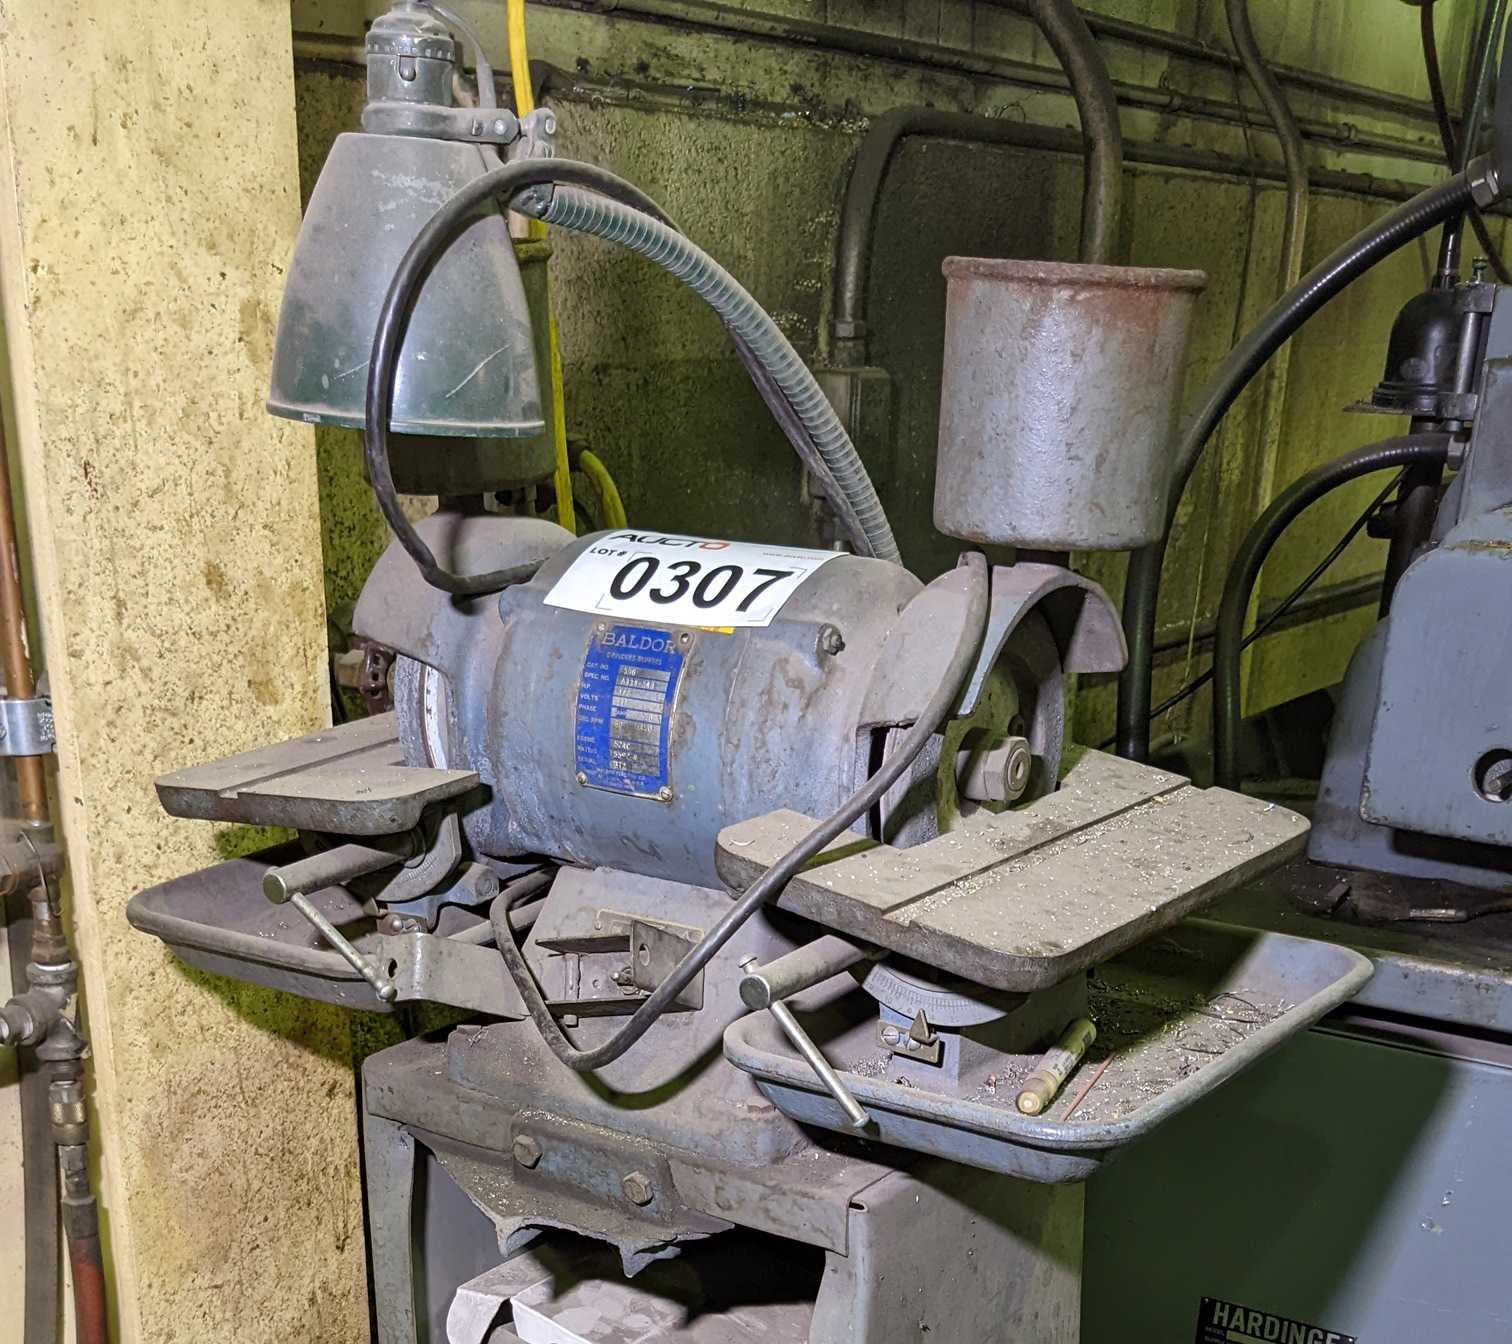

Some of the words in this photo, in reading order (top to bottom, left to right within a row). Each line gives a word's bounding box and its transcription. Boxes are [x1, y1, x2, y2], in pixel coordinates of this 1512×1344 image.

[609, 533, 730, 550] AUCTO
[609, 556, 794, 614] 0307
[602, 632, 676, 654] BALDOR
